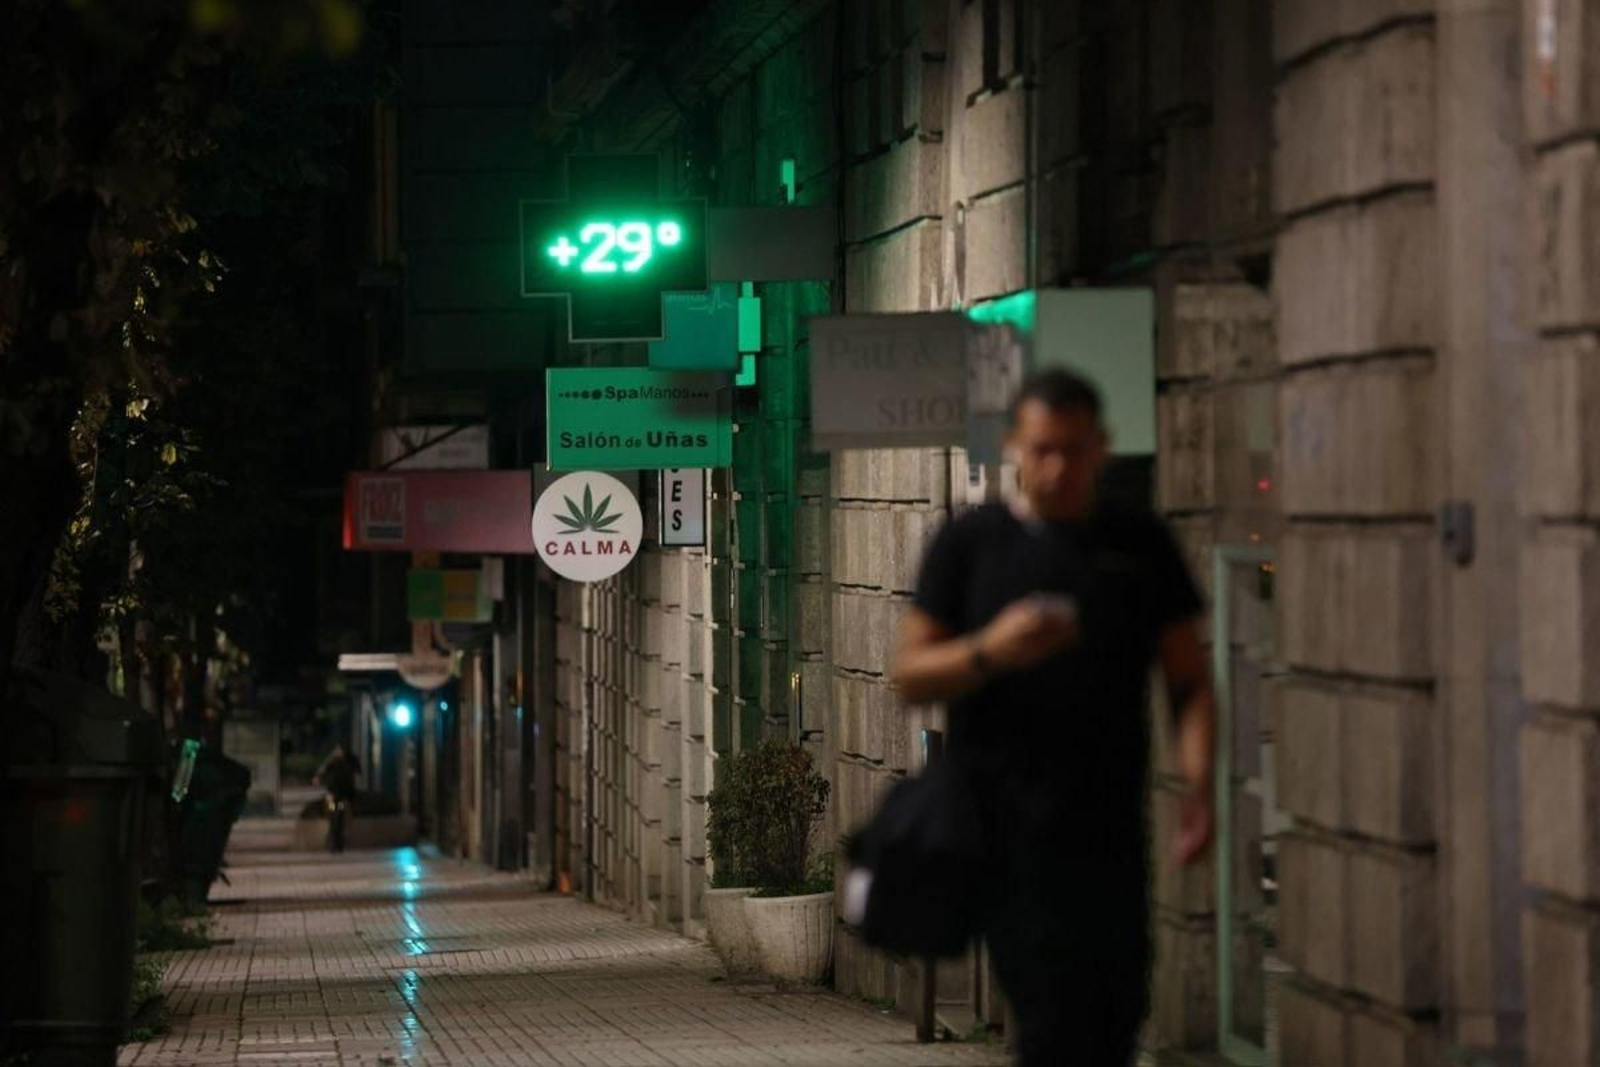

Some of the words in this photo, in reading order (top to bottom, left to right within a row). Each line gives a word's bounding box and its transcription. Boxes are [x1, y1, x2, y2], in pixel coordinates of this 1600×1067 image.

[560, 431, 620, 449] Salón
[625, 438, 642, 448] de
[646, 431, 708, 448] Uñas
[671, 469, 683, 532] ES
[545, 540, 632, 556] CALMA
